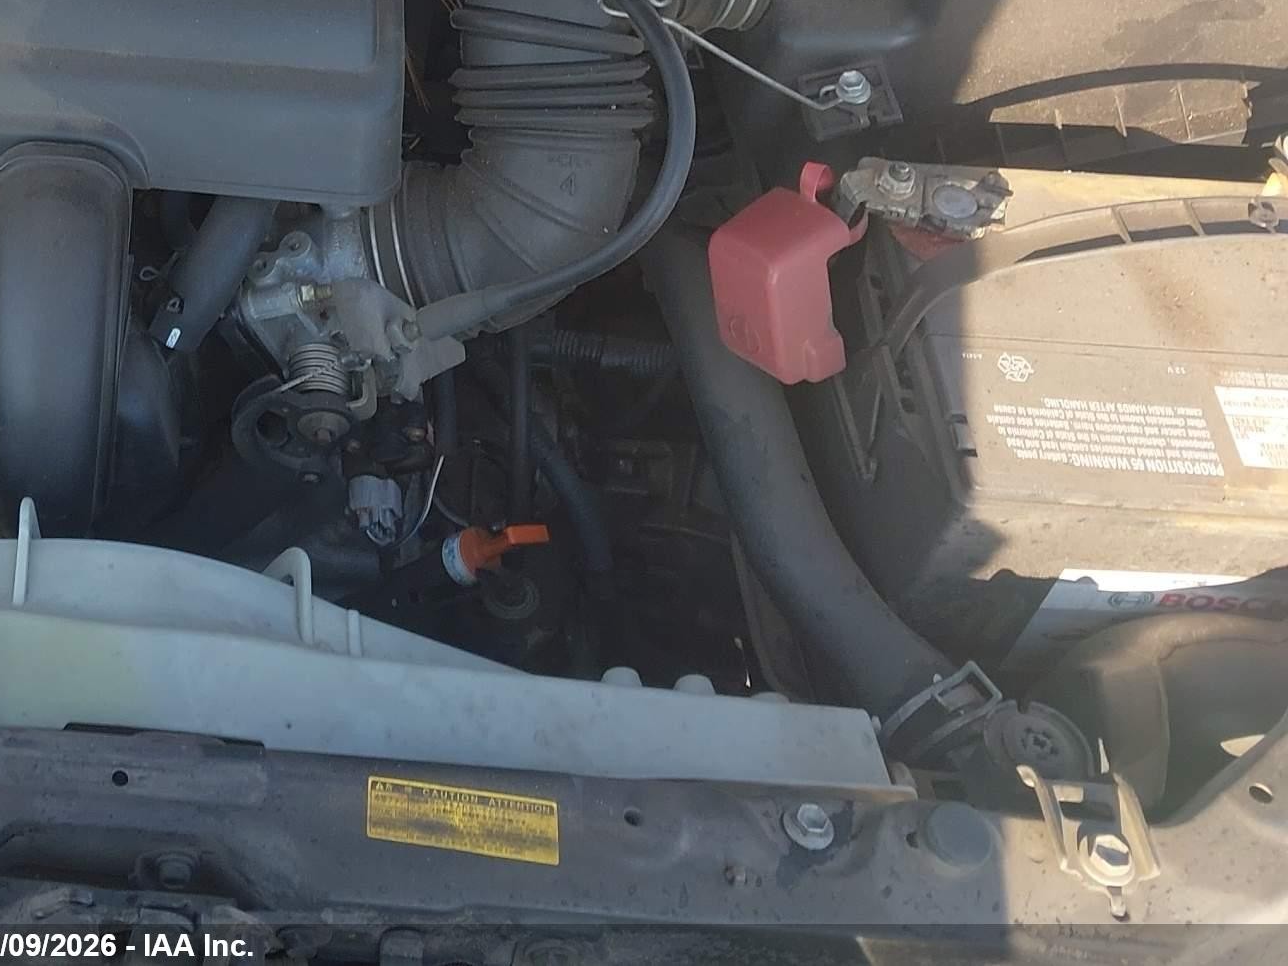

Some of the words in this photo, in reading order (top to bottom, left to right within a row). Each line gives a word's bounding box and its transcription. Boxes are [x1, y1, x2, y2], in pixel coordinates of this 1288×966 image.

[1068, 453, 1129, 469] WARNING:
[1145, 457, 1223, 476] PROPOSITION
[1157, 592, 1288, 613] BOSC
[422, 789, 479, 803] CAUTION
[488, 797, 551, 814] ATTENTION
